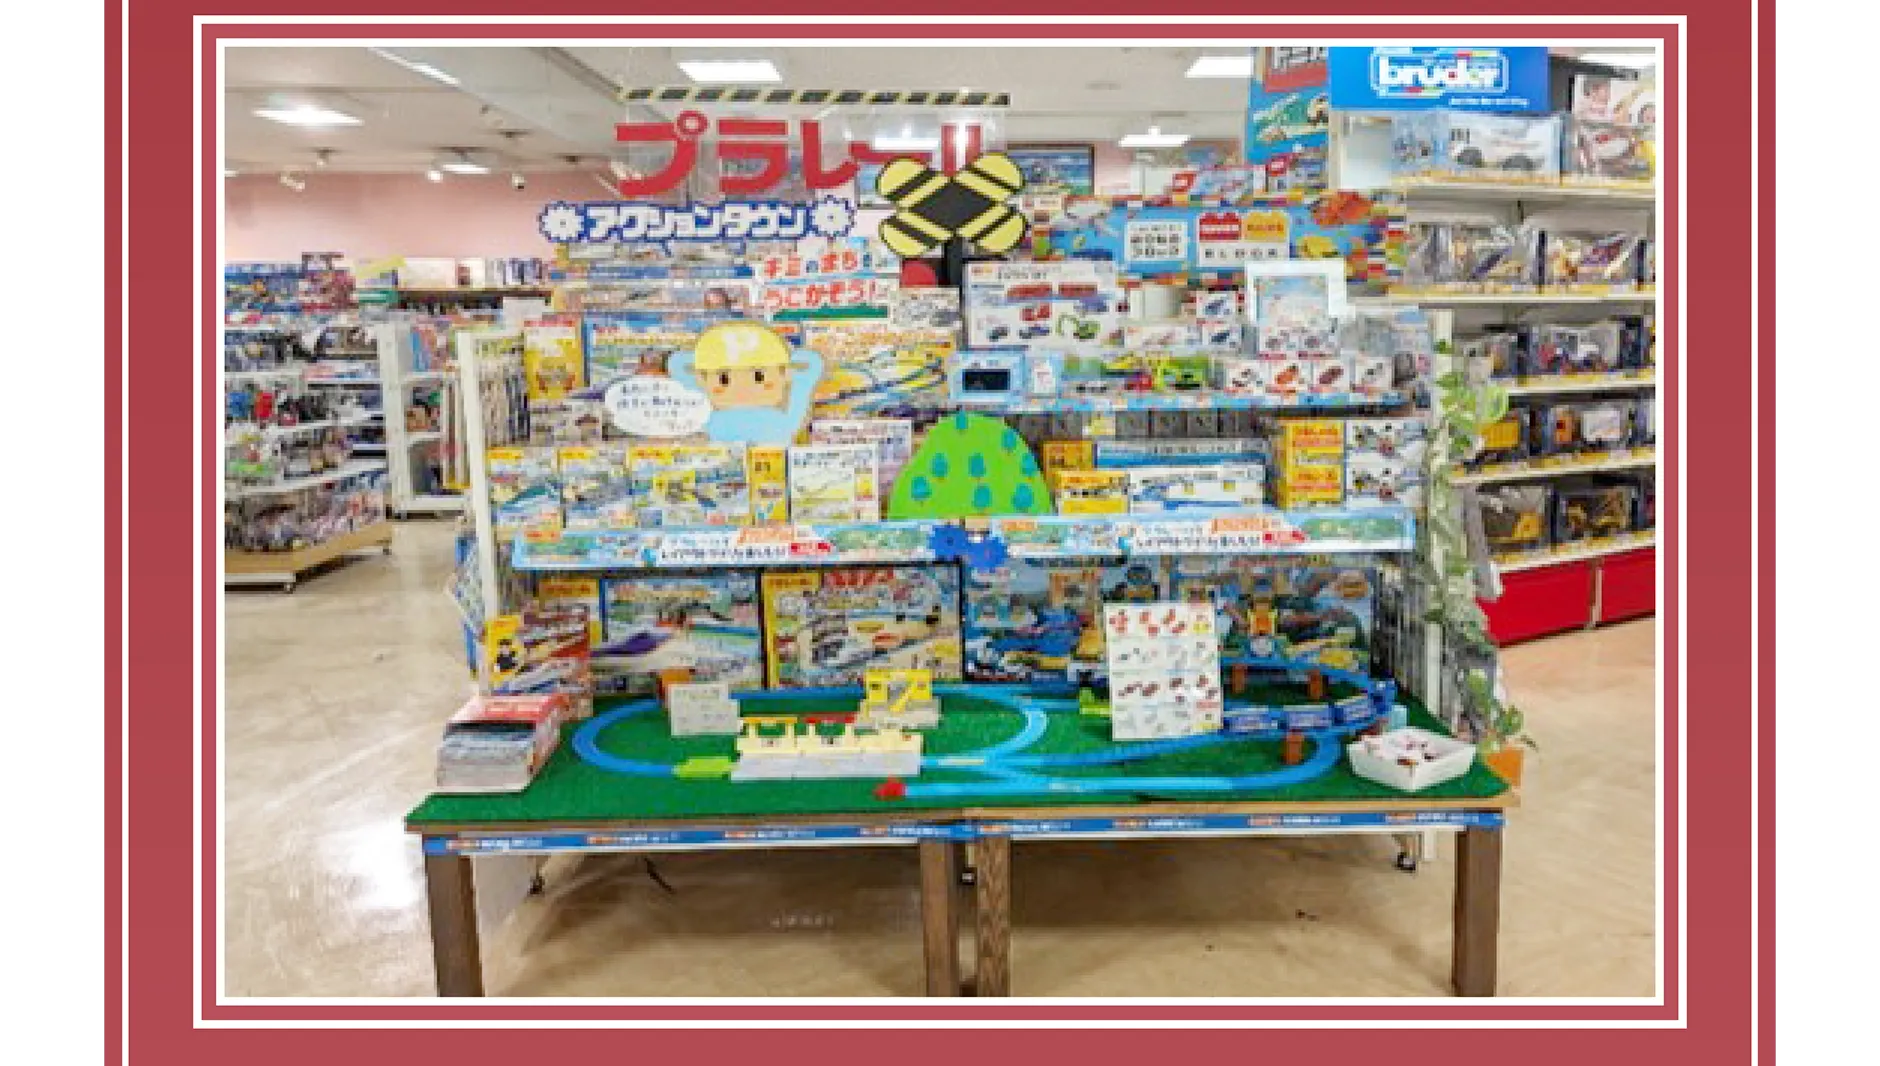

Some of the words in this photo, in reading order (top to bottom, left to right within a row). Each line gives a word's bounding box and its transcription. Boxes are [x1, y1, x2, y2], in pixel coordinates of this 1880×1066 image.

[1379, 56, 1502, 85] bruder
[586, 206, 806, 238] アクションタウン
